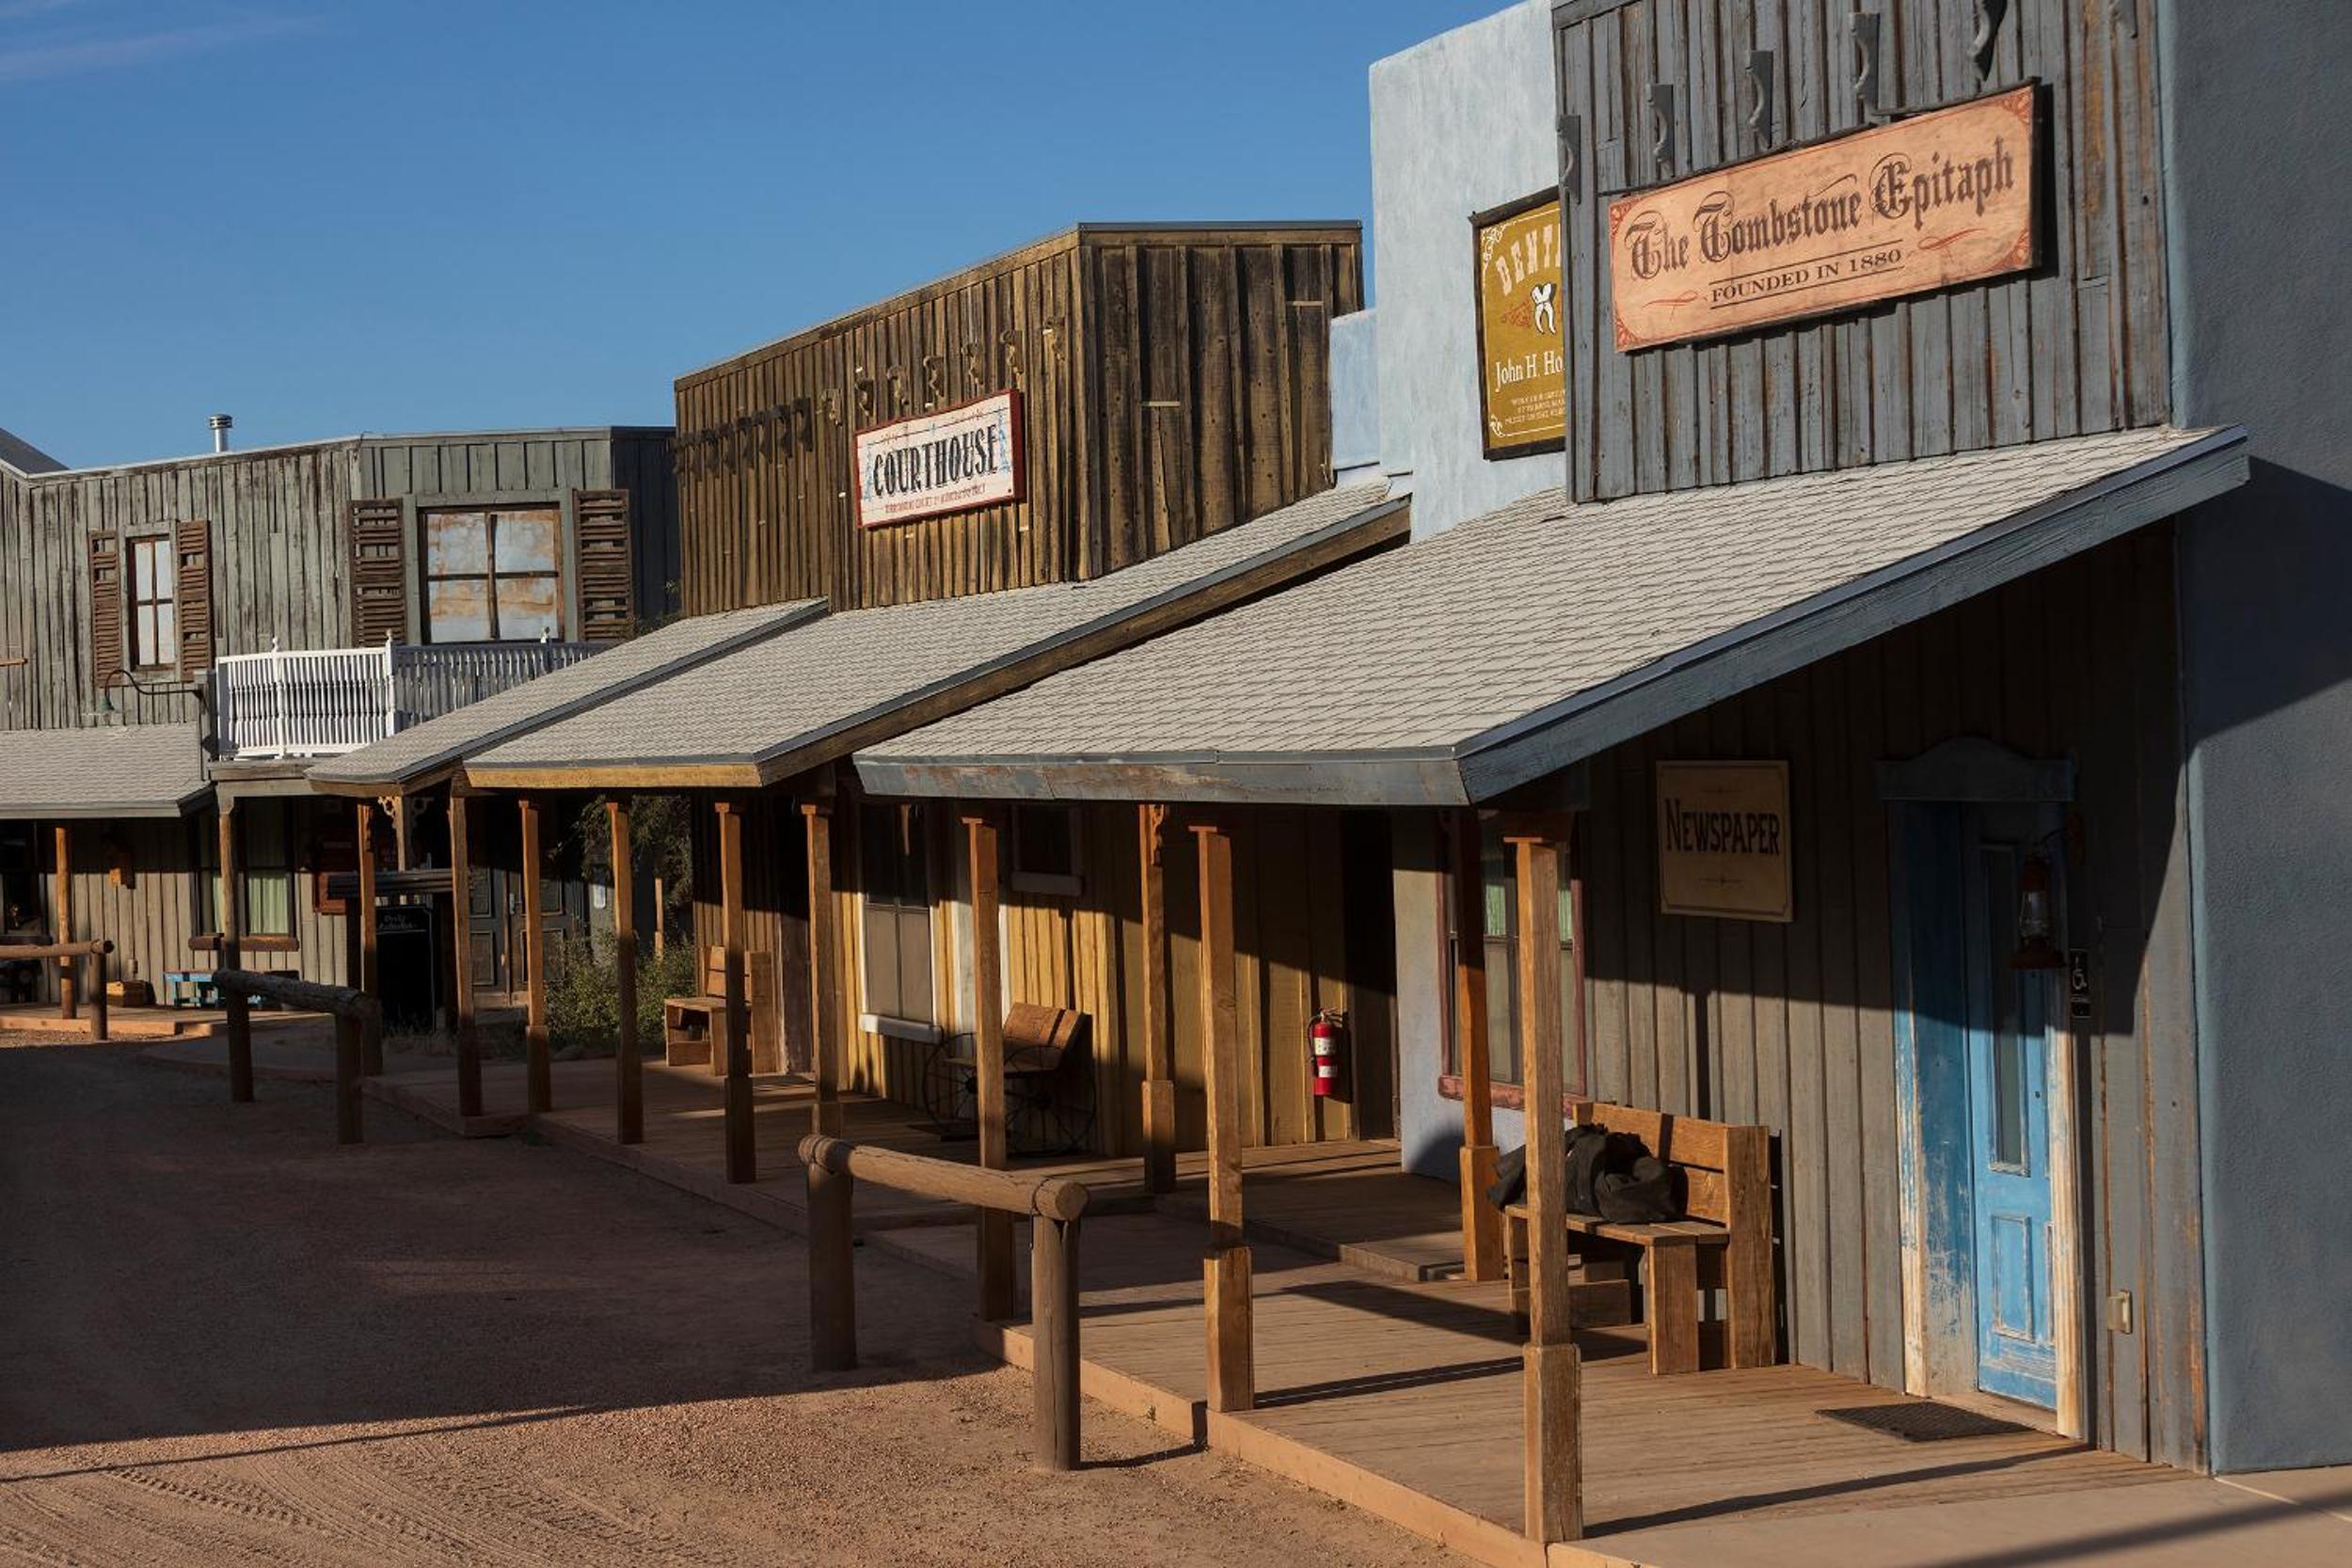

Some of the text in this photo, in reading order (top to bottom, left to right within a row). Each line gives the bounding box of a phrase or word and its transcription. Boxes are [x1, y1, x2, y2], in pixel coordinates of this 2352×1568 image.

[1624, 135, 2014, 279] The Tombstone Epitaph
[1710, 248, 1902, 302] FOUNDED IN 1880
[1495, 346, 1565, 393] John H. Ho
[873, 424, 997, 497] COURTHOUSE
[1665, 798, 1781, 856] NEWSPAPER
